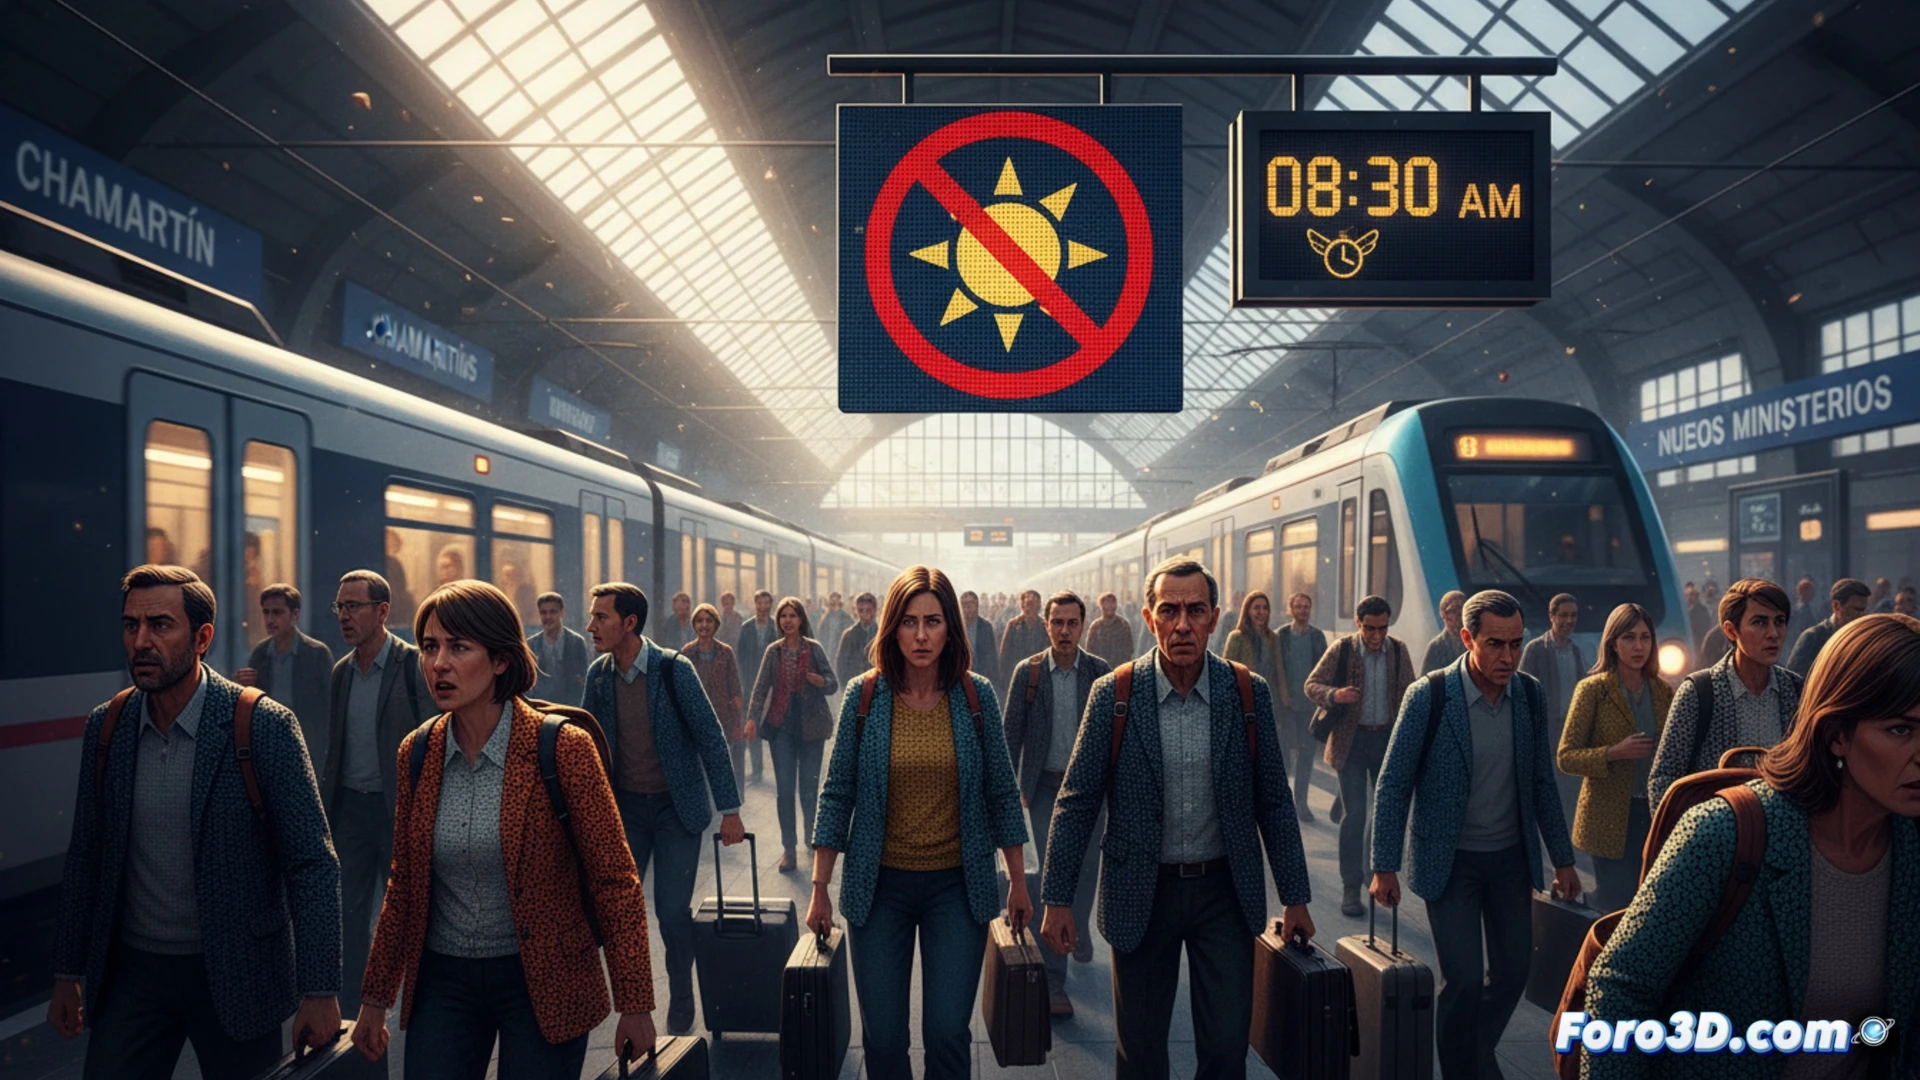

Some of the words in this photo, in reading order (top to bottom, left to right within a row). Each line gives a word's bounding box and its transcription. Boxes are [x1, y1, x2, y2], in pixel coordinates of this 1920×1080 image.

[15, 139, 215, 268] CHAMARTÍN
[1266, 155, 1438, 217] 08:30
[1458, 182, 1521, 219] AM
[1657, 414, 1726, 457] NUEOS
[1732, 373, 1893, 442] MINISTERIOS
